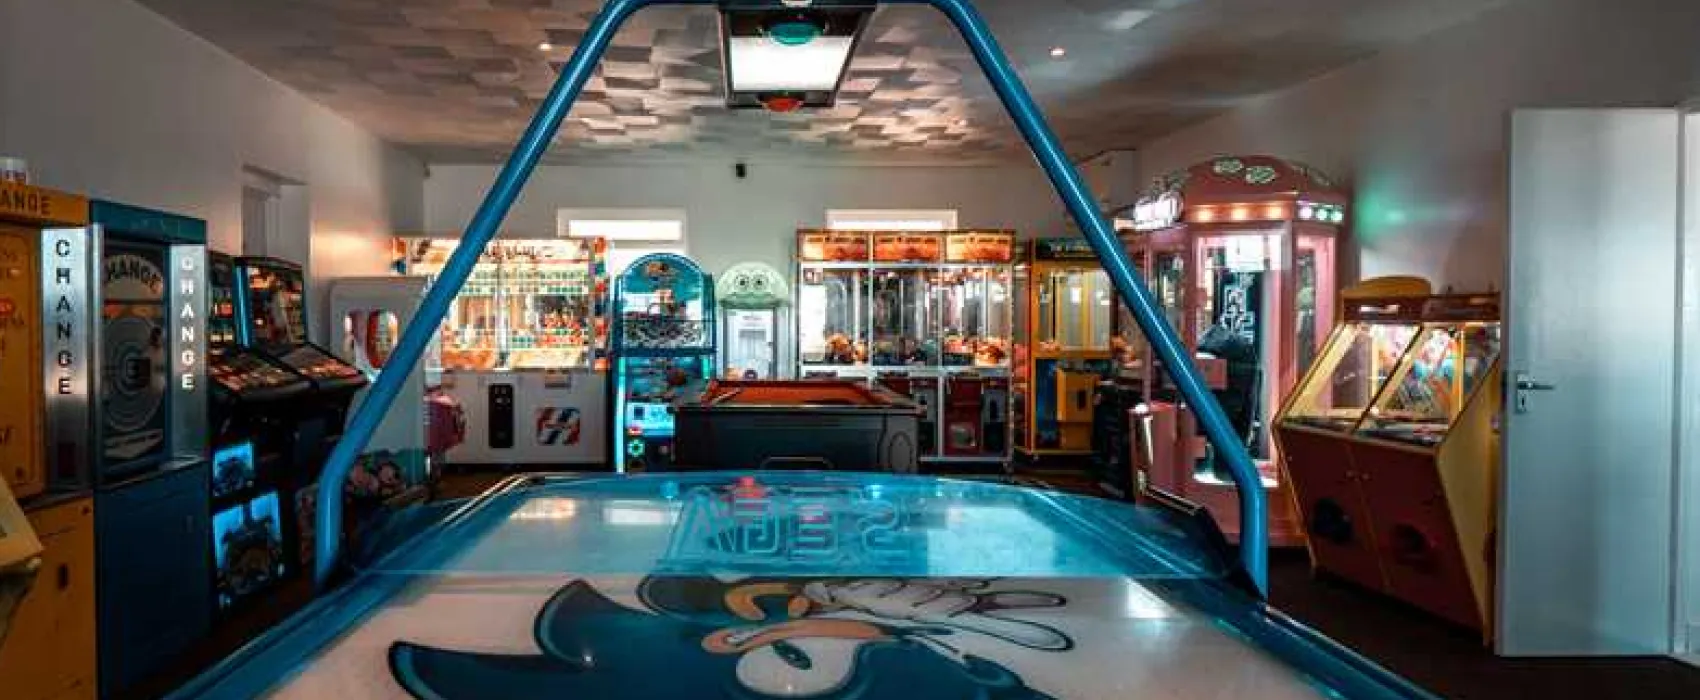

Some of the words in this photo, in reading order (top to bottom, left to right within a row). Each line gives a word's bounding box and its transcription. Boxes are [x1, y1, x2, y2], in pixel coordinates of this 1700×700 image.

[55, 239, 73, 395] CHANGE
[104, 257, 162, 294] HANGE
[181, 256, 196, 389] CHANGE
